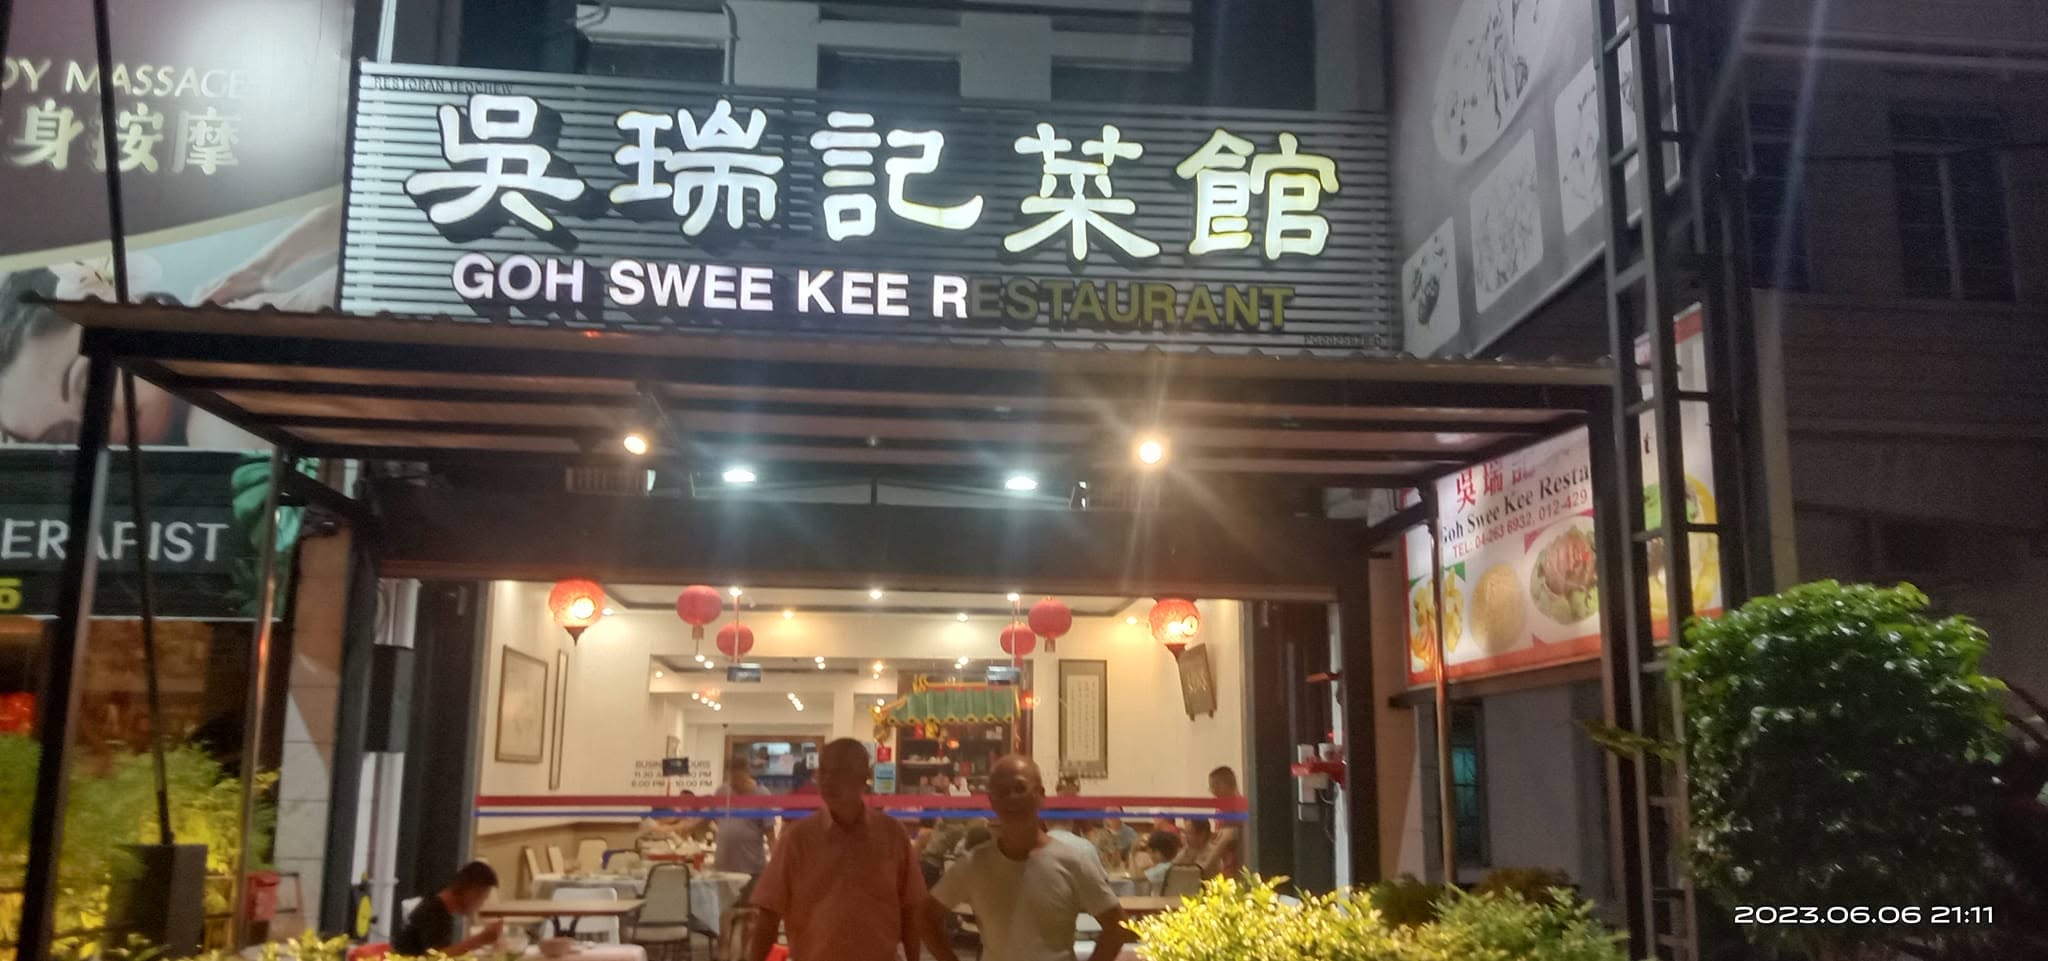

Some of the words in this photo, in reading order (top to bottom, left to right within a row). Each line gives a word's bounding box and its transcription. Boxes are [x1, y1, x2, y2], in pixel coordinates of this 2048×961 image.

[5, 97, 242, 176] 身按摩
[452, 254, 584, 303] GOH
[609, 260, 774, 311] SWEE
[798, 270, 910, 318] KEE
[933, 274, 1297, 329] RESTAURANT
[1, 518, 229, 562] ERPIST
[1467, 506, 1500, 533] Swee
[1504, 488, 1534, 515] Kee
